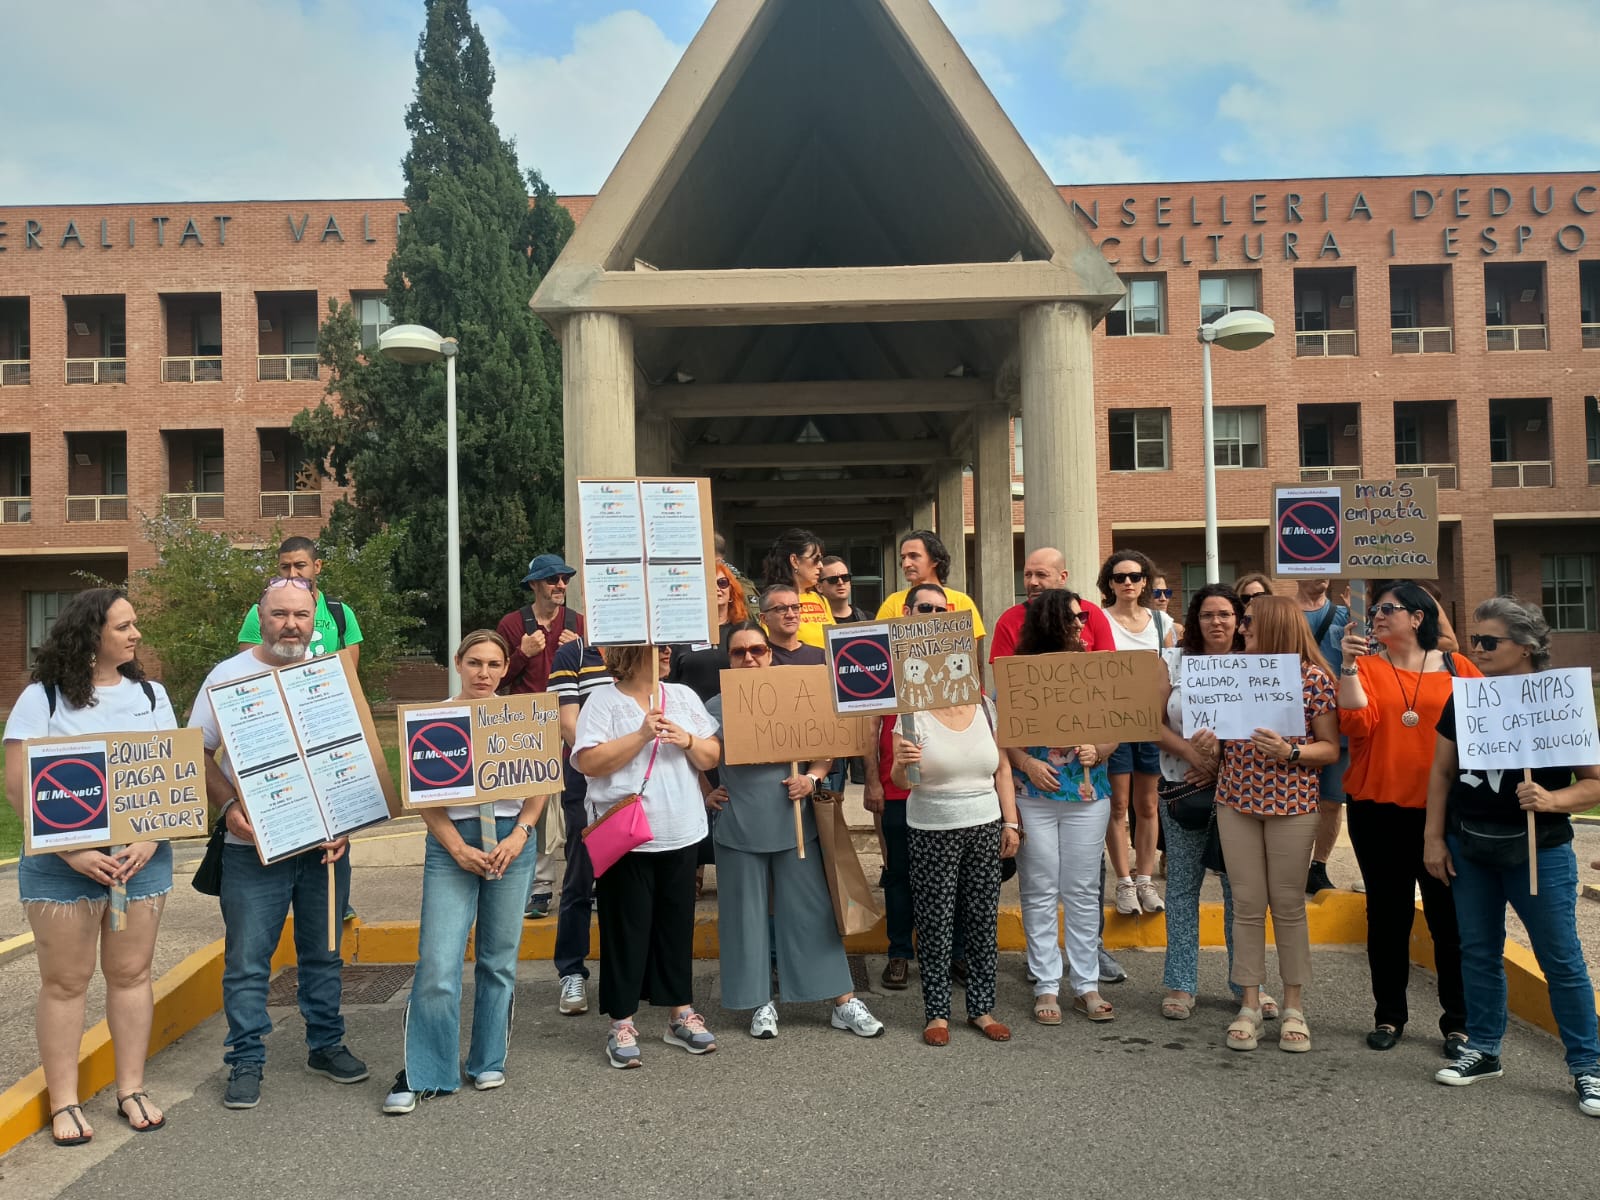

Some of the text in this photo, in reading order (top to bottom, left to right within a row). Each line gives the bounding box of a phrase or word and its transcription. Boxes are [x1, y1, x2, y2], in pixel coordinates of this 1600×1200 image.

[1411, 185, 1598, 220] D'EDUC
[1099, 223, 1588, 264] CULTURA I ESPO
[1354, 480, 1414, 498] más
[1344, 500, 1427, 525] empatía
[1354, 531, 1415, 546] menos
[1348, 550, 1433, 566] avaricia
[891, 616, 972, 640] ADMINISTRACIÓN
[893, 637, 972, 660] FANTASMA
[1187, 656, 1279, 672] POLÍTICAS DE
[1187, 676, 1280, 689] CALIDAD, PARA
[1464, 675, 1575, 708] LAS AMPAS
[738, 679, 817, 716] NO A
[1188, 691, 1294, 705] NUESTROS HIJOS
[477, 703, 526, 728] Nuestros
[1008, 716, 1041, 738] DE
[1191, 710, 1217, 730] YA!
[1466, 703, 1584, 734] DE CASTELLÓN
[109, 735, 173, 765] ¿QUIÉN
[487, 733, 543, 754] NO SON
[1467, 728, 1593, 756] EXIGEN SOLUCIÓN
[114, 761, 198, 790] PAGA LA
[477, 758, 561, 791] GANADO
[114, 786, 199, 813] SILLA DE
[130, 807, 205, 834] VÍCTOR?
